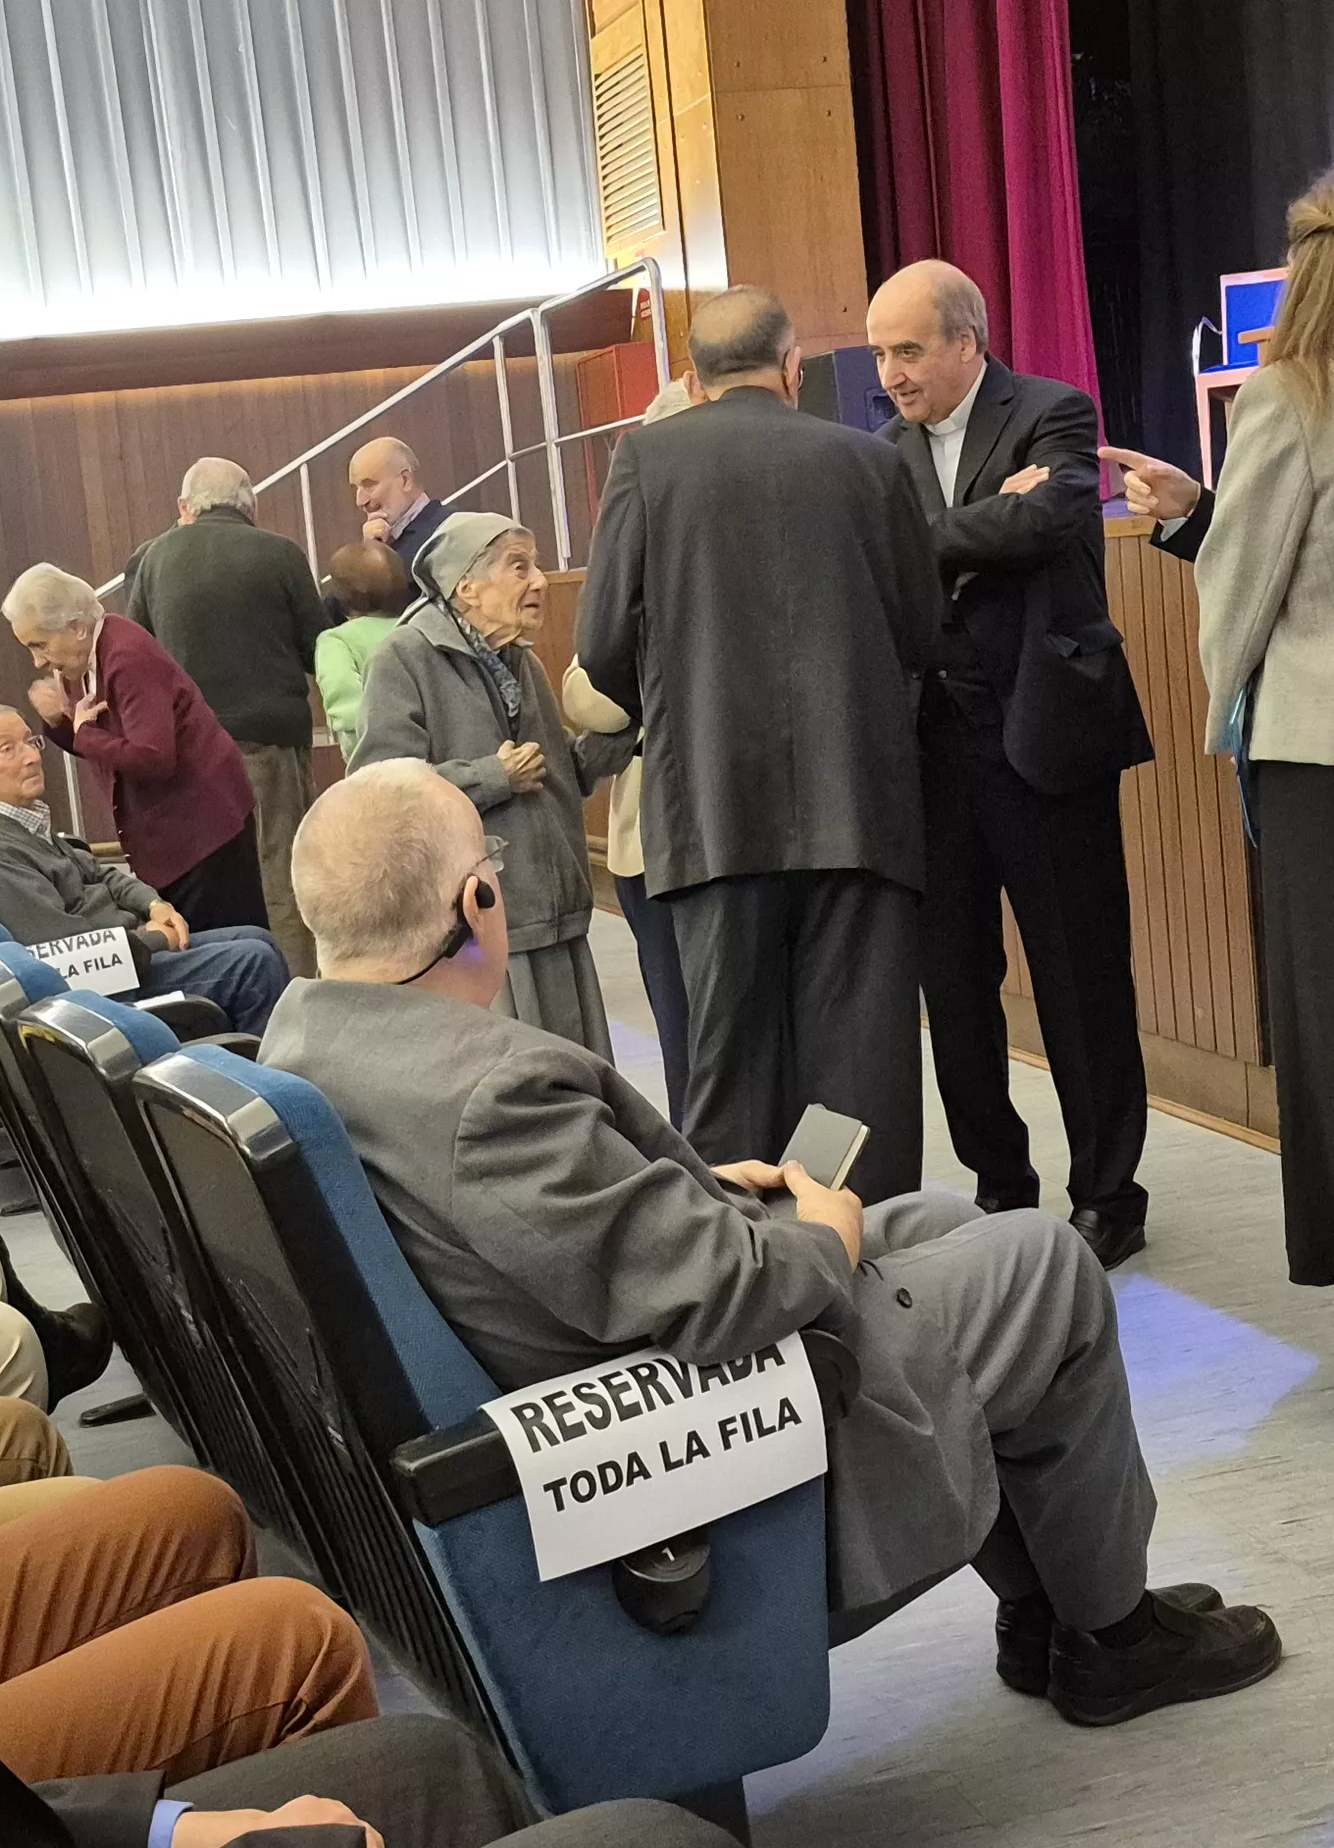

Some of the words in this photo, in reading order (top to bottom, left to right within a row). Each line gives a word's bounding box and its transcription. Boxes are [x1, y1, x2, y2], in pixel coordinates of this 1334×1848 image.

[83, 953, 123, 974] FILA
[543, 1451, 652, 1512] TODA
[659, 1430, 711, 1473] LA
[718, 1397, 802, 1451] FILA
[661, 1547, 675, 1562] 1
